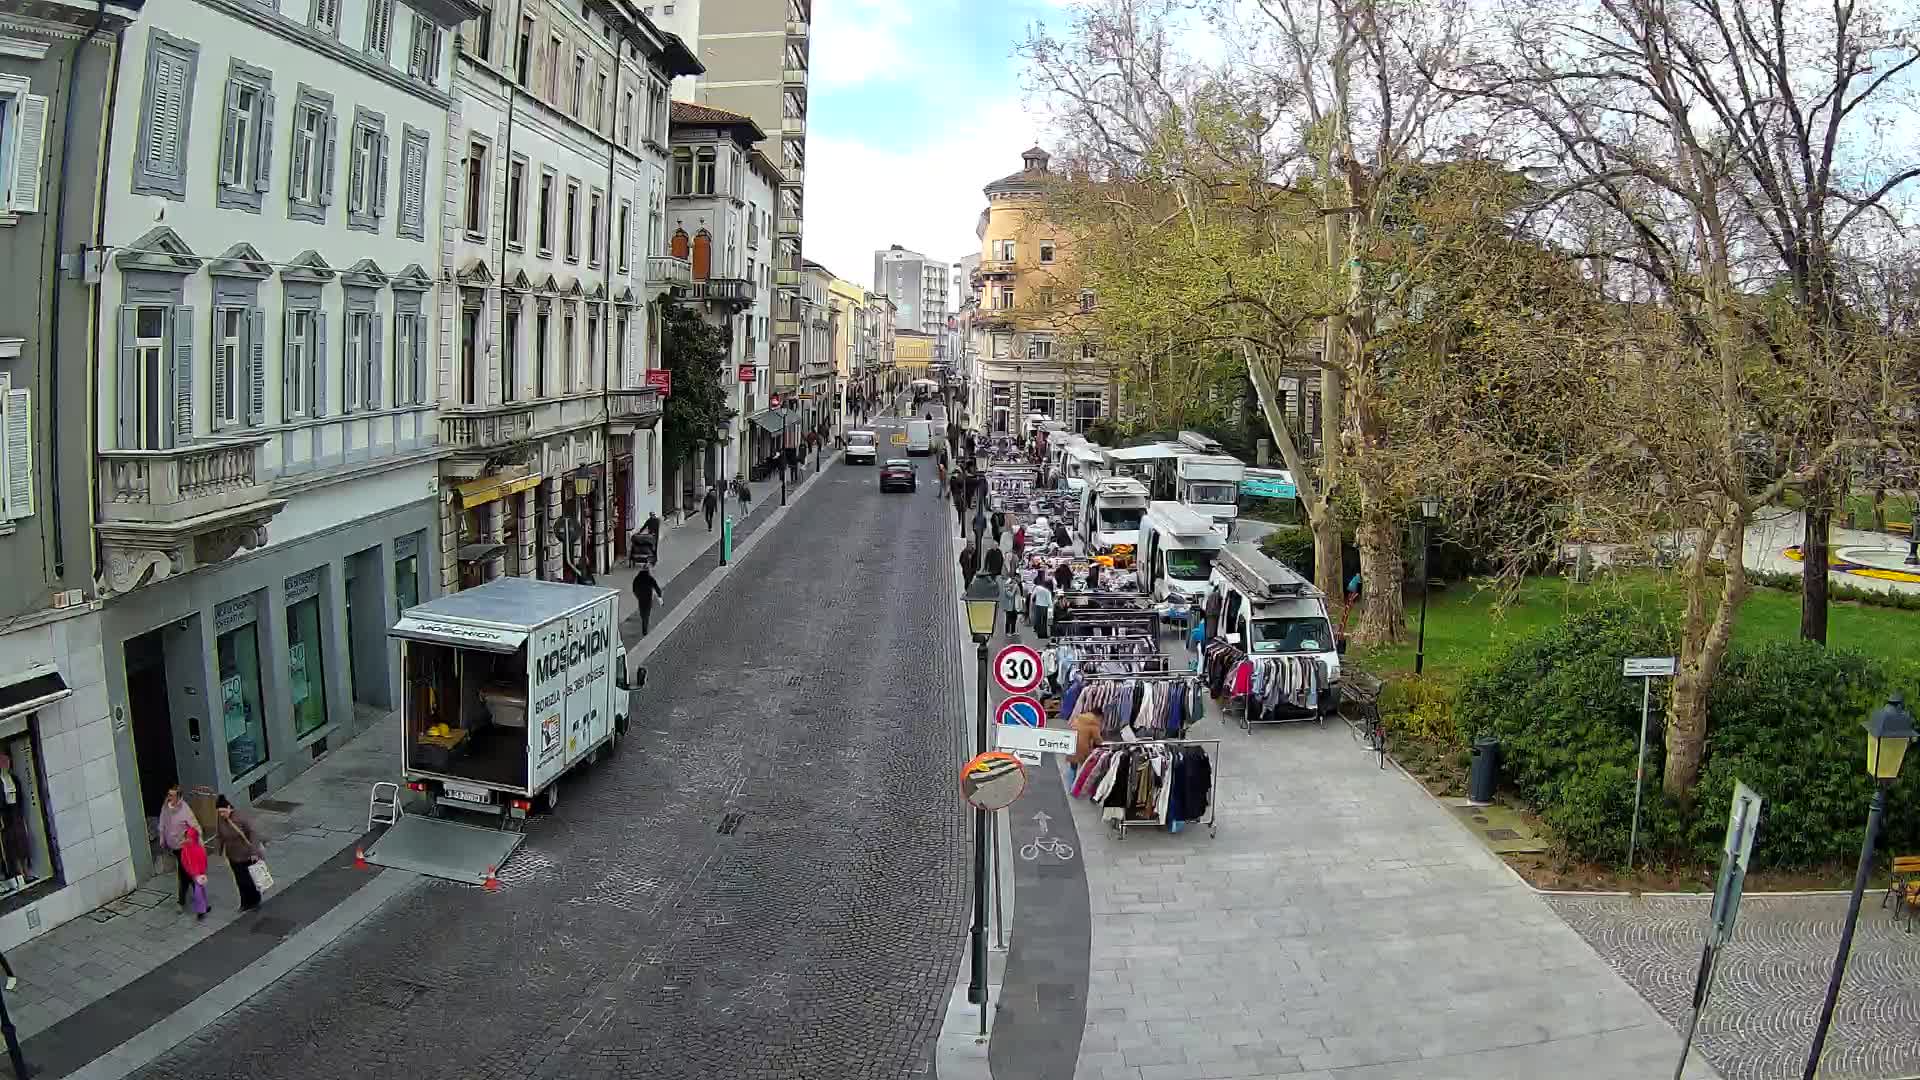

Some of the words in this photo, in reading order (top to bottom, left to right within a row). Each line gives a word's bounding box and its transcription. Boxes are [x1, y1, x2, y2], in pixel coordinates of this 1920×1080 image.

[417, 624, 501, 639] MOSCHION
[536, 624, 609, 686] MOSCHION
[1006, 658, 1032, 680] 30
[1039, 738, 1069, 749] Dante
